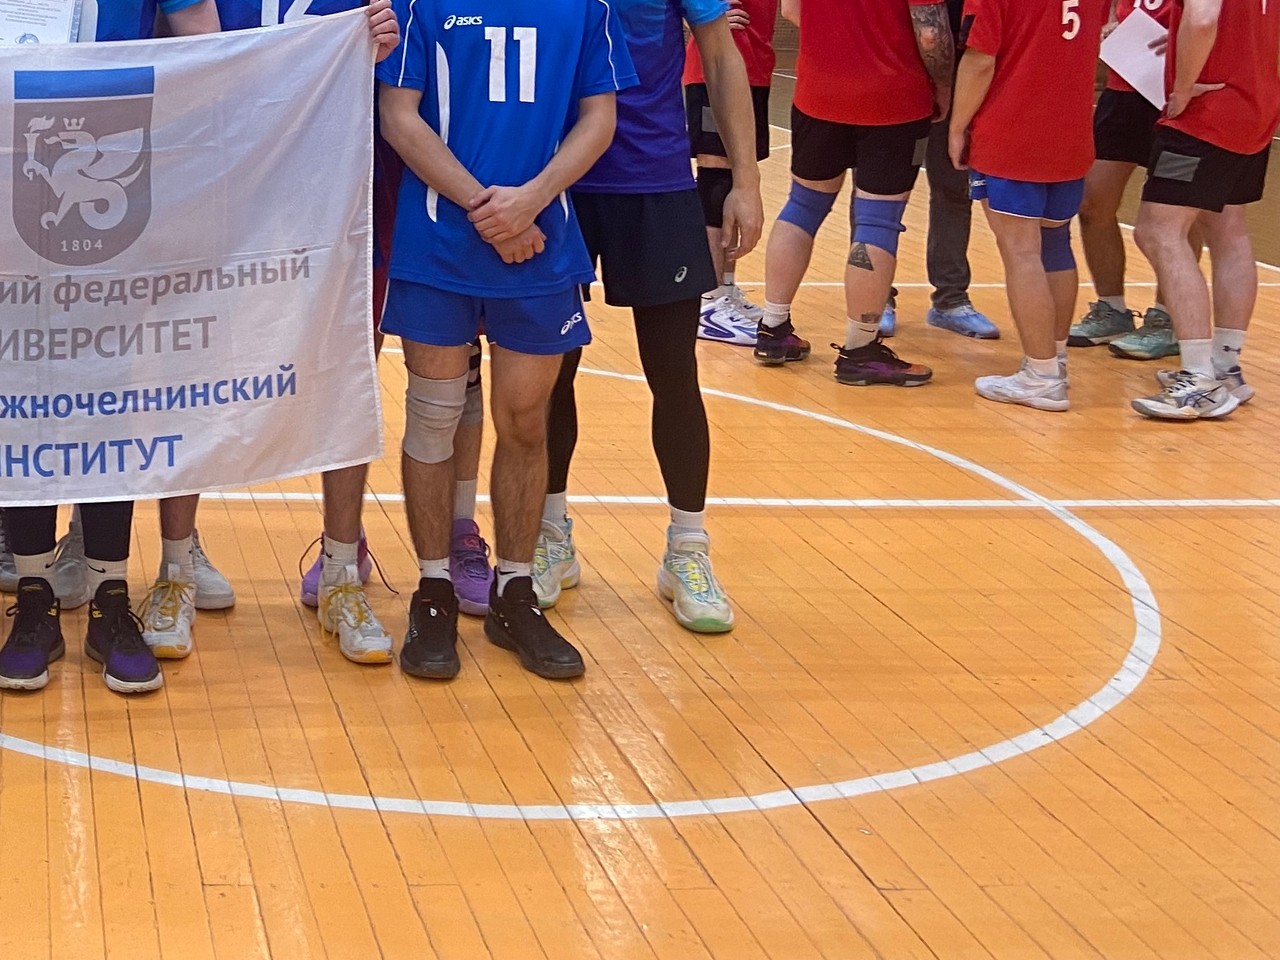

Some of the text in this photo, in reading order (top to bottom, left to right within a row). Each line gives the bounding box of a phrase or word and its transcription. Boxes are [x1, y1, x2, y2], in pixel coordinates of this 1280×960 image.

[455, 16, 483, 26] asics
[484, 26, 537, 103] 11
[60, 239, 103, 252] 1804
[53, 247, 311, 312] федеральный
